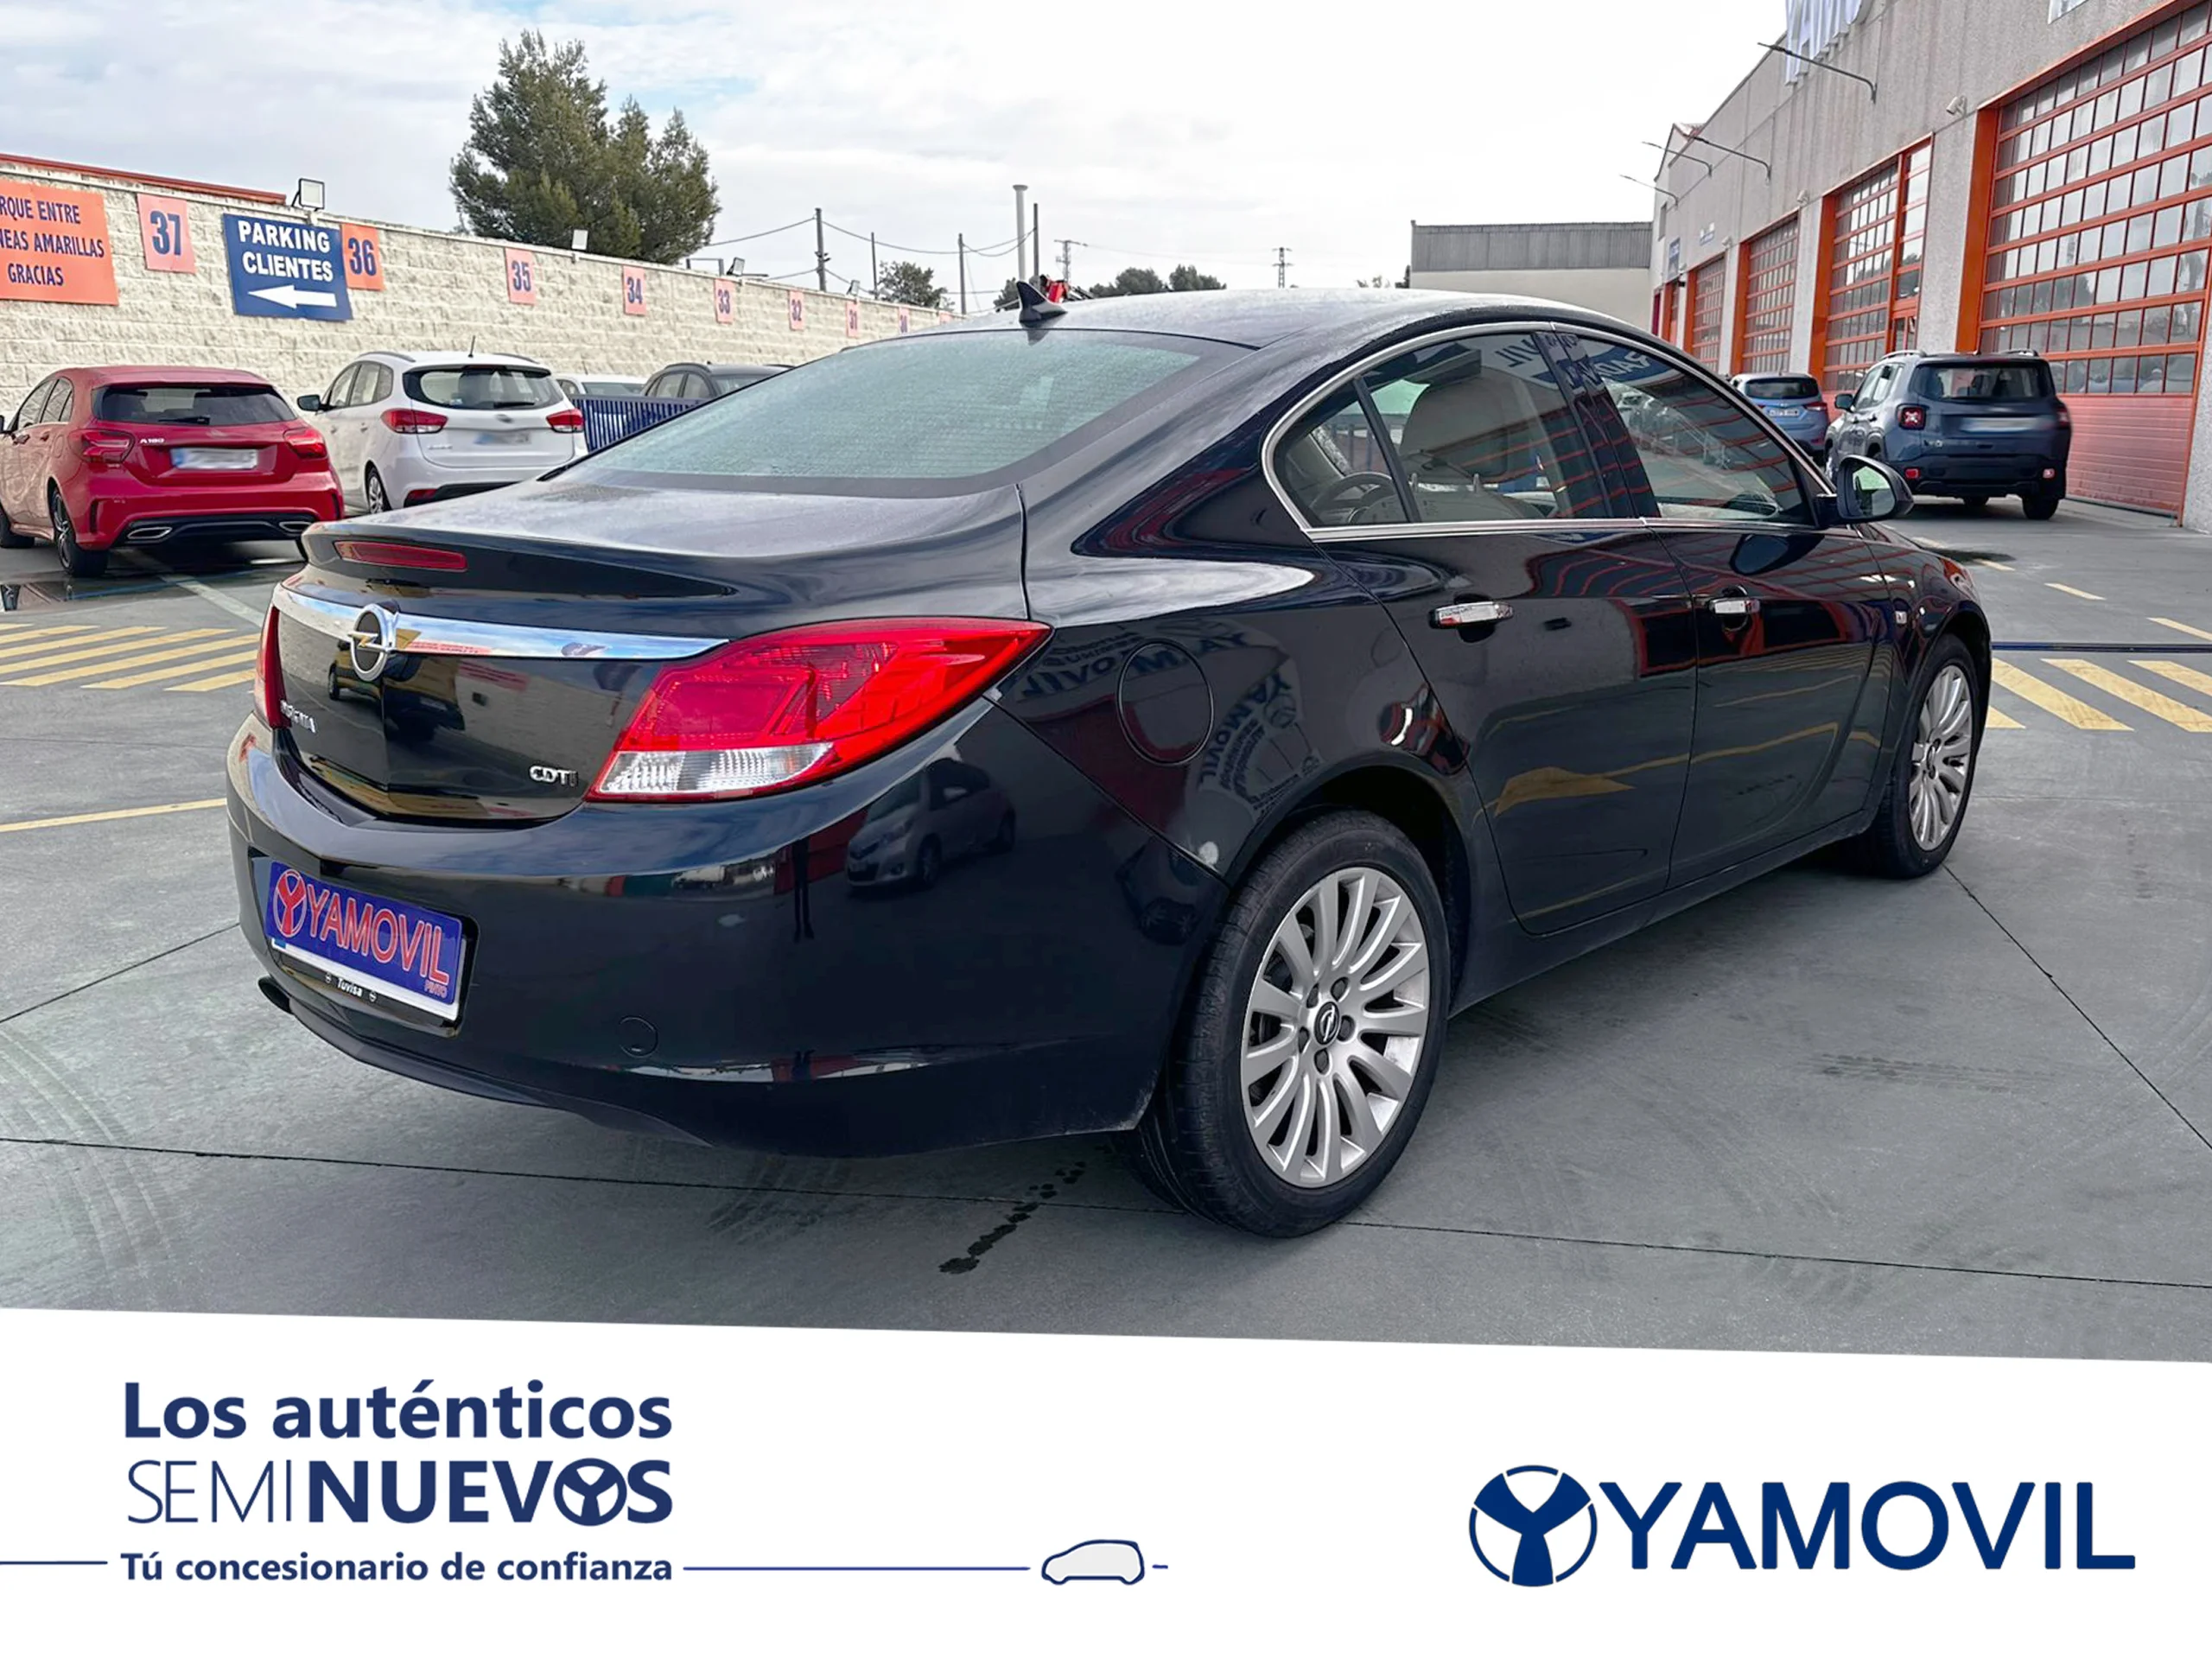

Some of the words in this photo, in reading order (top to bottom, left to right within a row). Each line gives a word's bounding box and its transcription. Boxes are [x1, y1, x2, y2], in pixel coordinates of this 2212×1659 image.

[37, 200, 80, 224] ENTRE
[35, 232, 105, 257] AMARILLAS
[150, 210, 181, 256] 37
[238, 219, 331, 253] PARKING
[243, 251, 334, 282] CLIENTES
[348, 238, 377, 276] 36
[8, 263, 64, 286] GRACIAS
[512, 260, 531, 291] 35
[626, 276, 643, 304] 34
[718, 289, 730, 314] 33
[308, 884, 449, 985] YAMOVIL
[337, 976, 363, 997] Tuvisa
